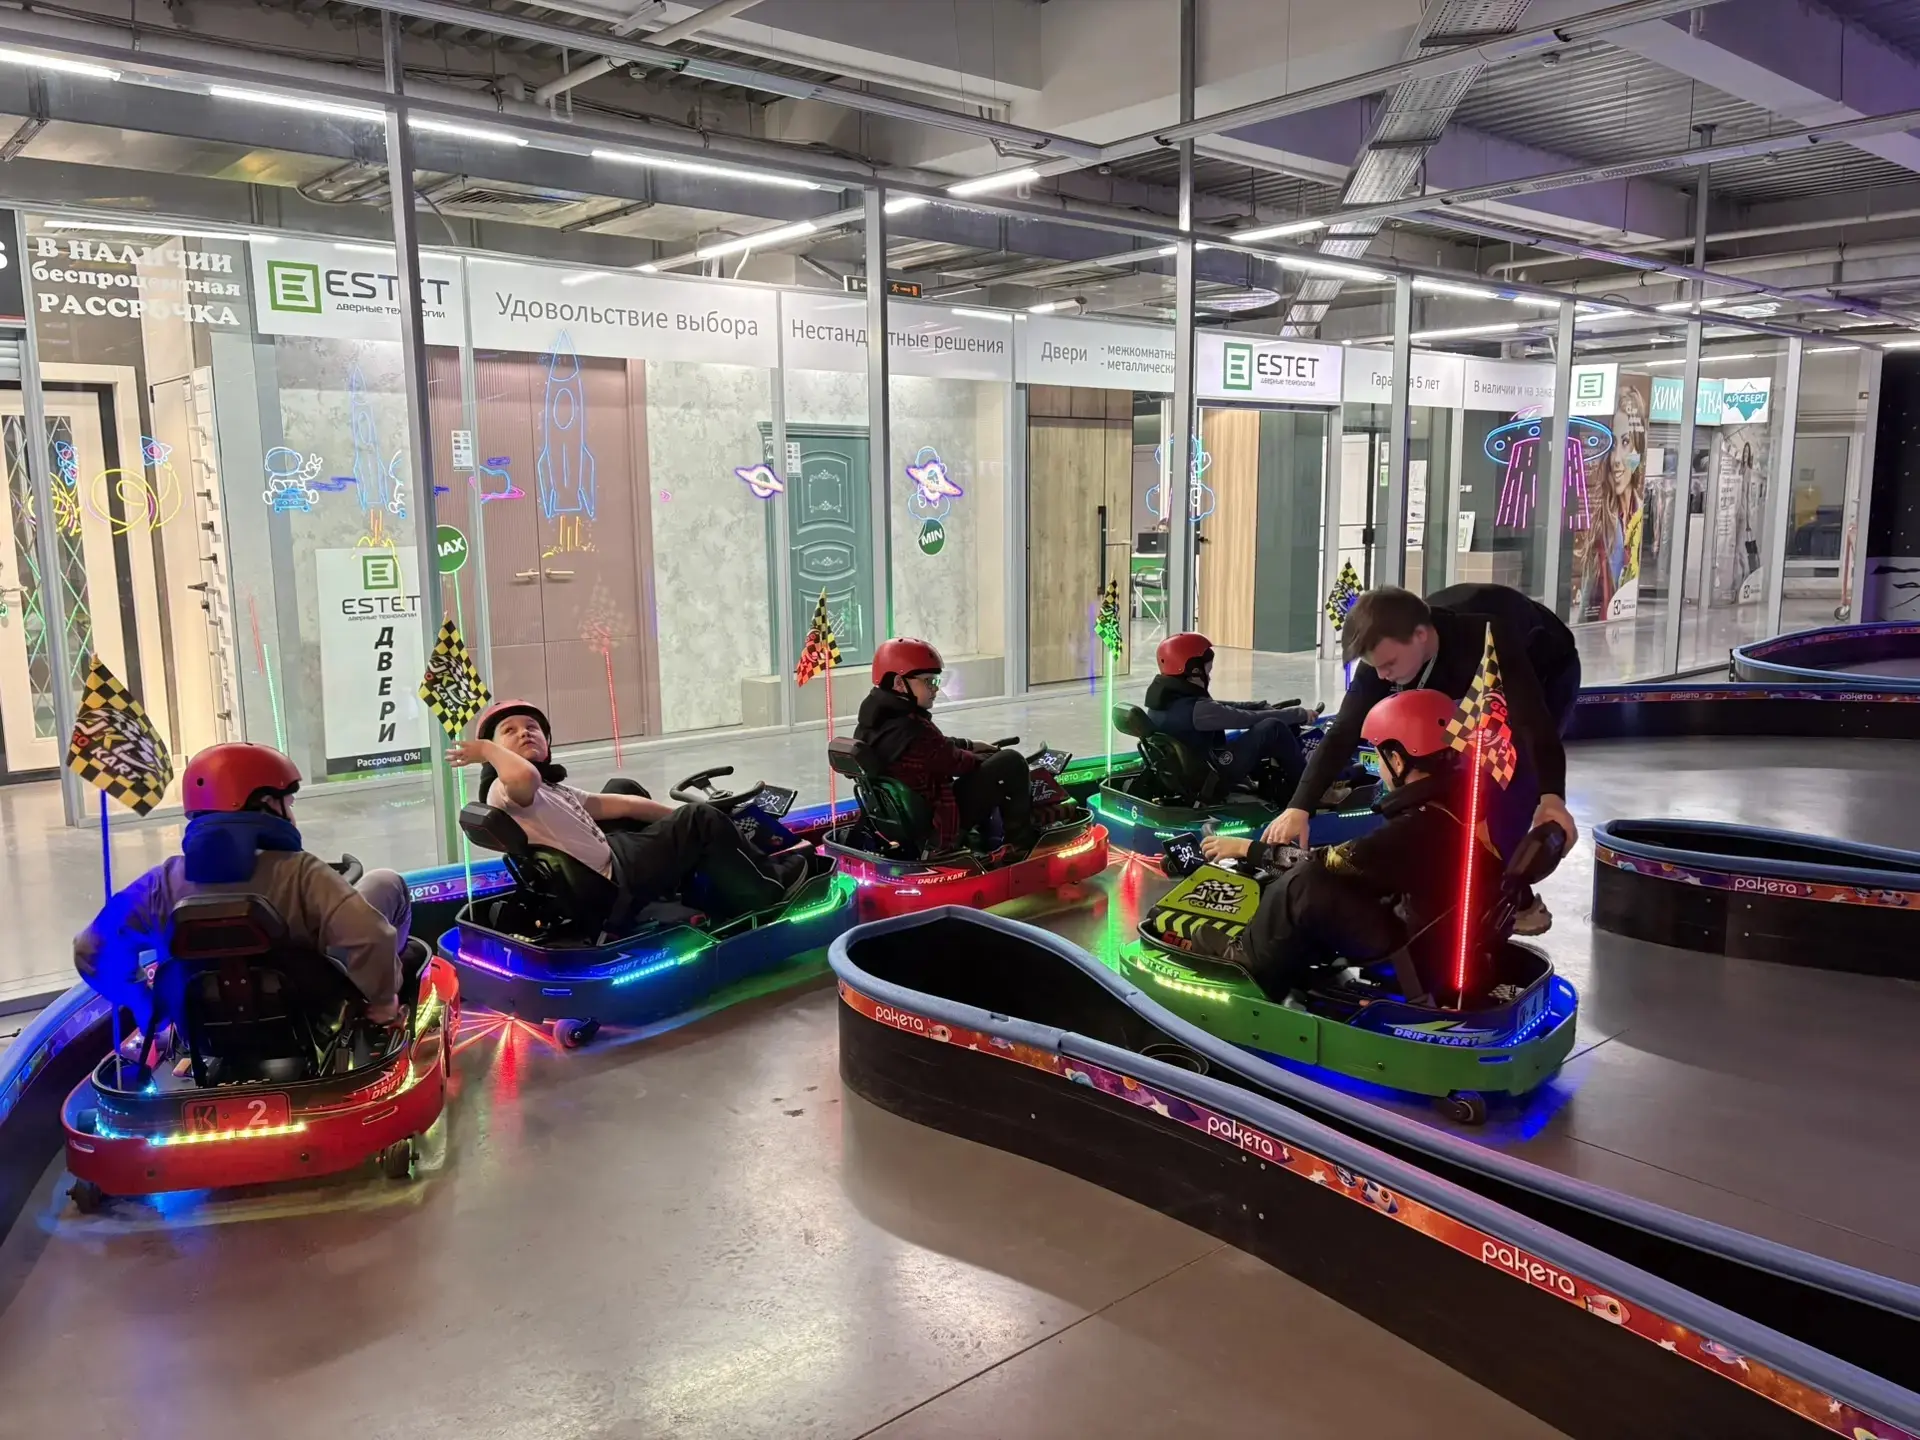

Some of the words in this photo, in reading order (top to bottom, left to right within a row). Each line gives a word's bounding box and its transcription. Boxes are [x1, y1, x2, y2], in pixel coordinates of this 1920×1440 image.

[36, 237, 59, 257] В
[68, 240, 232, 273] НАЛИЧИИ
[325, 269, 450, 305] ESTT
[37, 293, 240, 326] РАССРОЧКА
[496, 291, 668, 329] Удовольствие
[676, 310, 759, 340] выбора
[792, 318, 929, 349] Нестандтные
[934, 334, 1004, 354] решения
[1041, 341, 1088, 364] Двери
[1257, 353, 1319, 378] ESTET
[1416, 376, 1423, 389] 5
[1425, 379, 1441, 390] лет
[1474, 380, 1480, 393] В
[1482, 384, 1516, 395] наличии
[1726, 393, 1765, 404] АЙСБЕРГ
[921, 528, 943, 546] MIN
[342, 596, 420, 615] ESTET
[433, 683, 457, 712] KART
[1839, 692, 1873, 701] ракета
[90, 746, 142, 780] KART
[357, 755, 402, 767] Рассрочка
[403, 751, 421, 762] 0%!
[1131, 805, 1138, 820] 6
[1224, 820, 1244, 828] KART
[917, 877, 944, 885] DRIFT
[947, 872, 967, 882] KART
[1734, 877, 1797, 895] ракета
[1206, 901, 1241, 914] KART
[503, 947, 512, 967] 7
[609, 960, 638, 975] DRIFT
[639, 950, 668, 965] KART
[1155, 963, 1179, 978] KART
[875, 1005, 924, 1032] ракета
[1394, 1027, 1437, 1042] DRIFT
[1439, 1036, 1479, 1046] KART
[371, 1078, 403, 1100] DRIFT
[247, 1100, 269, 1125] 2
[1207, 1113, 1273, 1157] ракета
[1482, 1240, 1576, 1298] ракета
